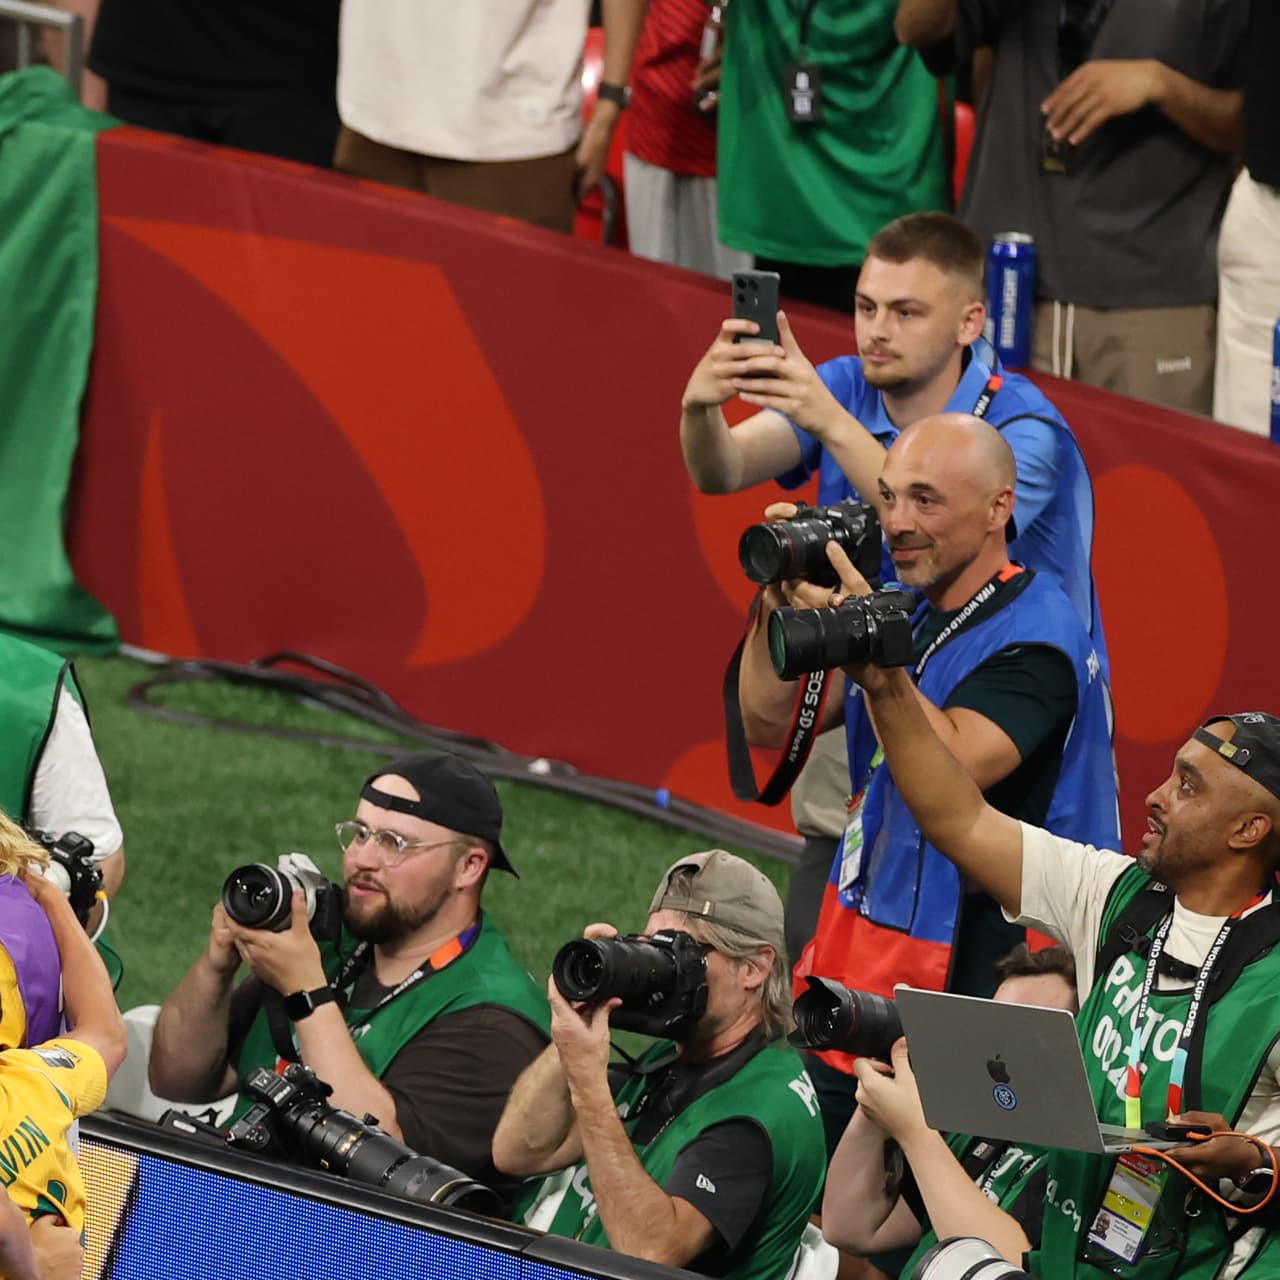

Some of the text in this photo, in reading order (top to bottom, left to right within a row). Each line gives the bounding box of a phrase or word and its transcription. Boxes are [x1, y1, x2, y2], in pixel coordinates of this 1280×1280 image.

[804, 669, 824, 706] EOS
[799, 708, 815, 729] 5D
[1216, 926, 1231, 946] FIFA
[1143, 959, 1157, 995] WORLD
[1150, 938, 1163, 958] CUP
[1200, 946, 1222, 979] WORLD
[1194, 979, 1206, 1001] CUP
